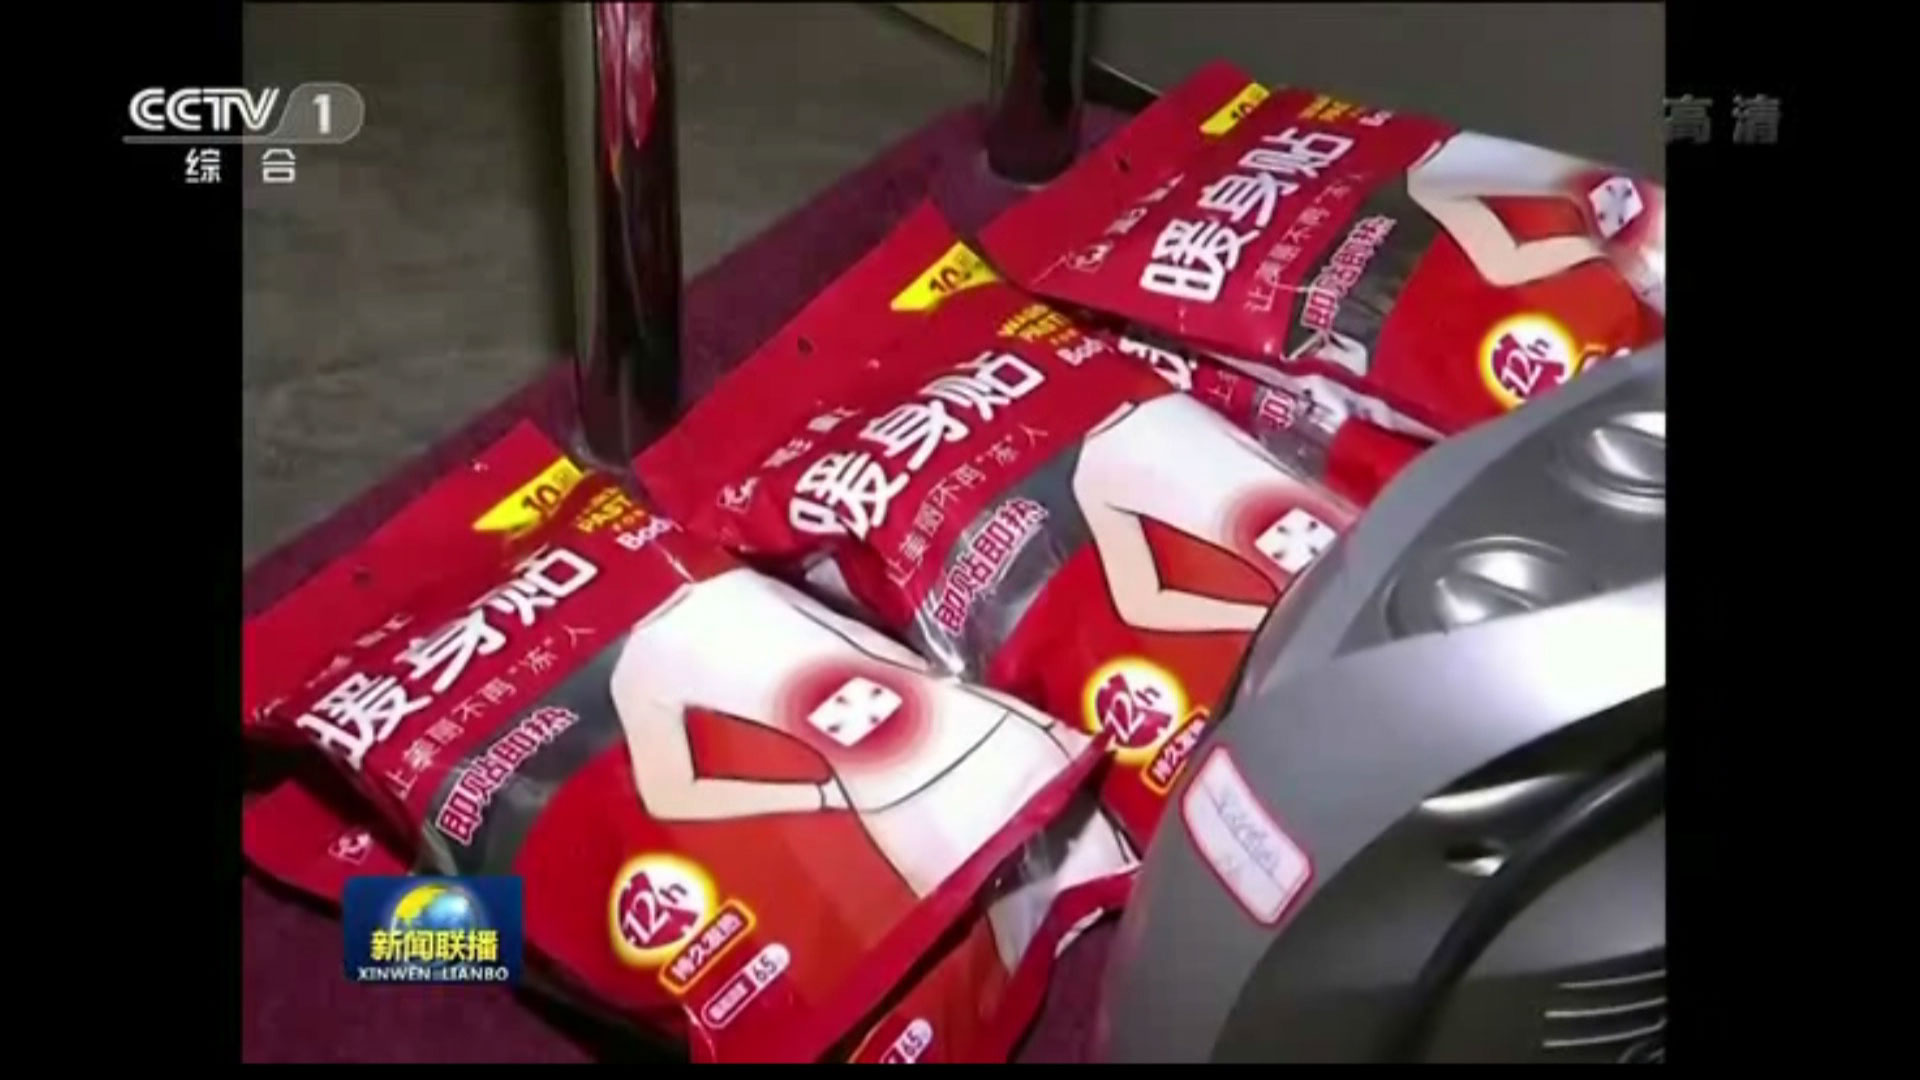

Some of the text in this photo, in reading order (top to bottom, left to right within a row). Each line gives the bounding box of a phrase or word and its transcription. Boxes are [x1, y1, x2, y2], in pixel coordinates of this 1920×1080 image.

[1139, 127, 1356, 301] 暖身贴
[788, 350, 1046, 540] 暖身贴
[933, 497, 1048, 635] 即贴即热
[297, 543, 599, 769] 暖身贴
[435, 706, 579, 845] 即贴即热
[624, 883, 687, 943] 12h
